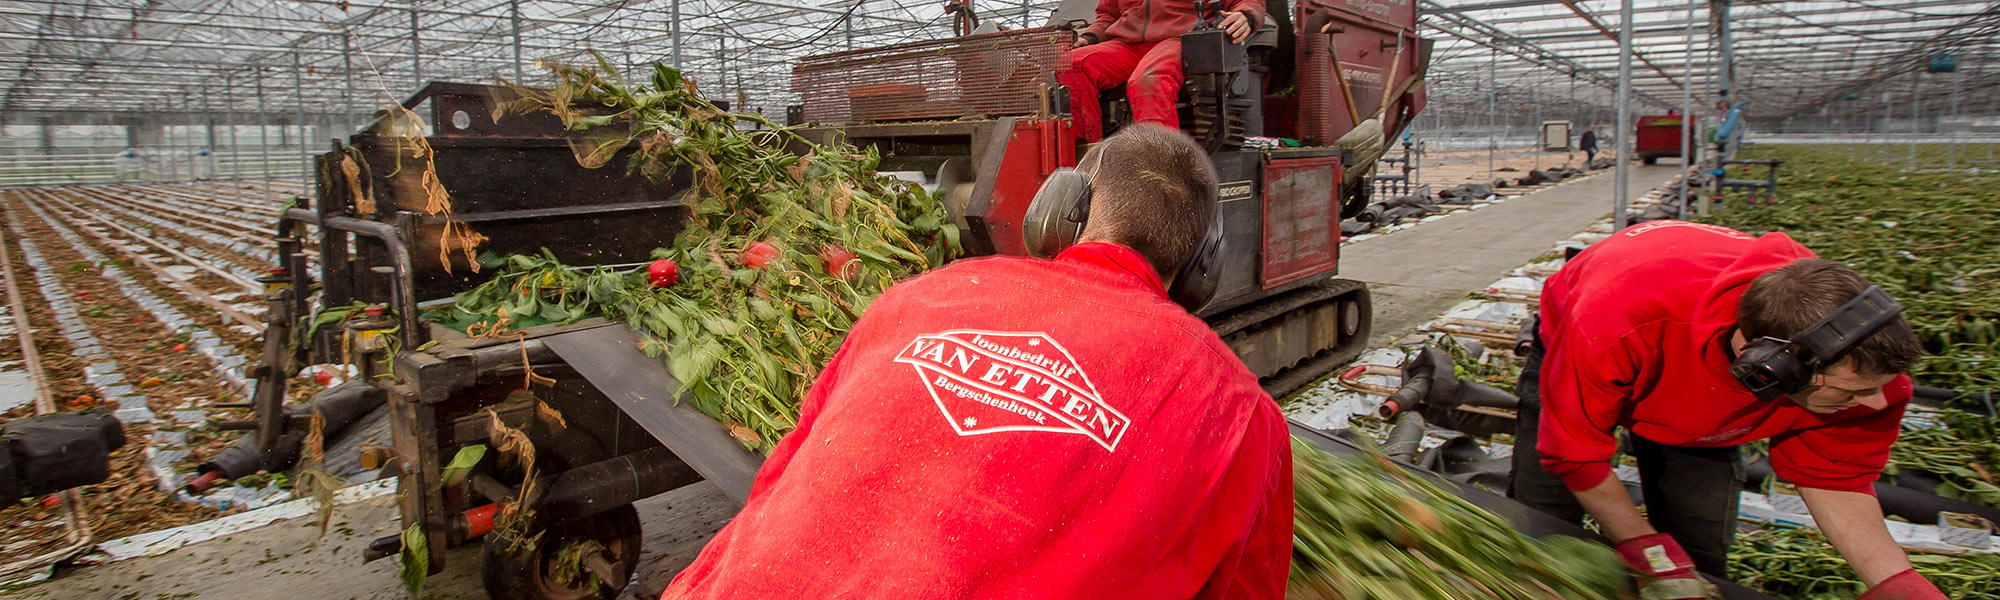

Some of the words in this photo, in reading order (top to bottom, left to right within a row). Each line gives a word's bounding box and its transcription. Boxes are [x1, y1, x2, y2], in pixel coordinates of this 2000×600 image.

[971, 334, 1077, 380] loonbedrijf
[911, 340, 980, 374] VAN
[979, 362, 1121, 440] ETTEN
[933, 375, 1047, 425] Bergschenhoek
